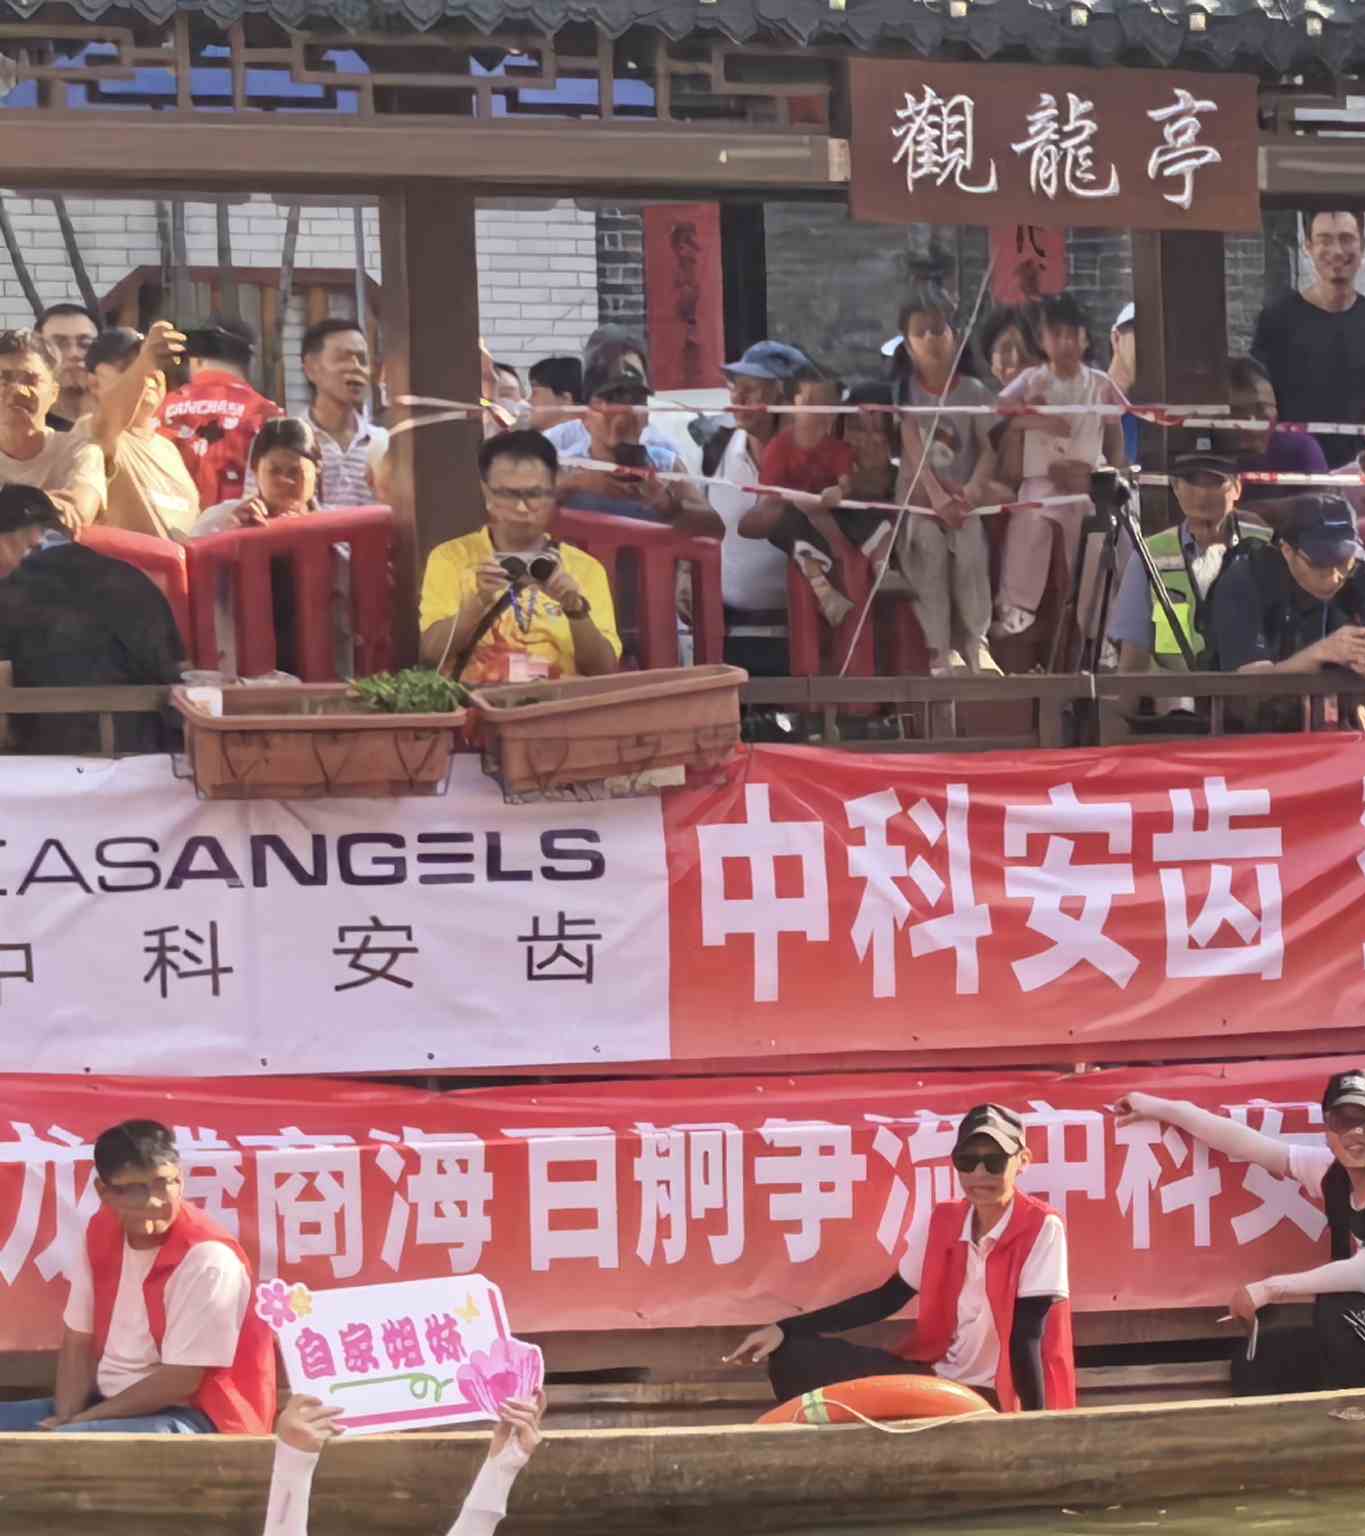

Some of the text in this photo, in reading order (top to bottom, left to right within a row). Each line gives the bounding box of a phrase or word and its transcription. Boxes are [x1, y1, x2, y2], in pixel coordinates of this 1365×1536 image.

[891, 83, 1222, 210] 觀龍亭
[0, 828, 606, 896] ASANGELS
[696, 776, 1284, 1002] 中科安齿
